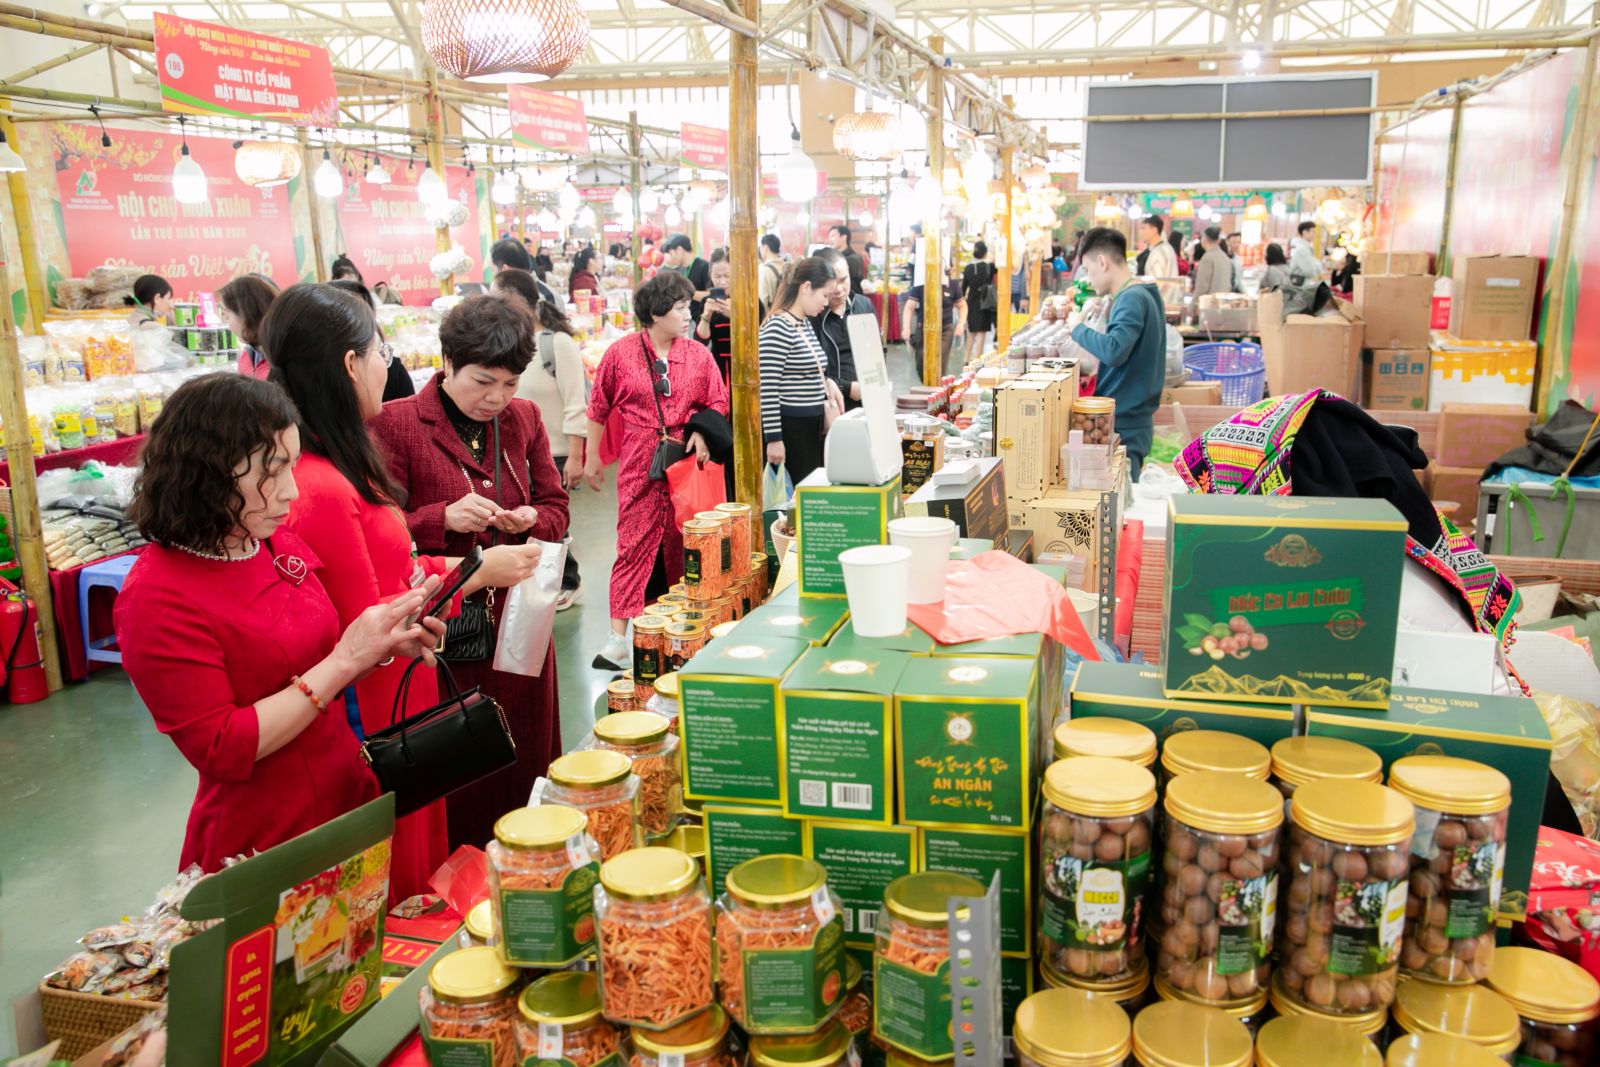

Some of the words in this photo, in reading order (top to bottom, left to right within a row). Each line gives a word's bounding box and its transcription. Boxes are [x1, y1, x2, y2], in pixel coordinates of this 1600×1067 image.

[218, 64, 242, 82] CÔNG
[243, 69, 254, 83] TY
[255, 67, 267, 86] CỔ
[268, 71, 291, 90] PHẦN
[214, 83, 233, 102] MẬT
[276, 93, 299, 109] XANH
[117, 190, 145, 222] HỘI
[147, 195, 178, 222] CHỢ
[215, 193, 252, 218] XUÂN
[130, 223, 150, 240] LẦN
[160, 257, 189, 278] sản
[189, 252, 224, 281] Việt
[1347, 671, 1365, 681] 1000
[933, 778, 951, 790] AN
[956, 777, 992, 791] NGÂN
